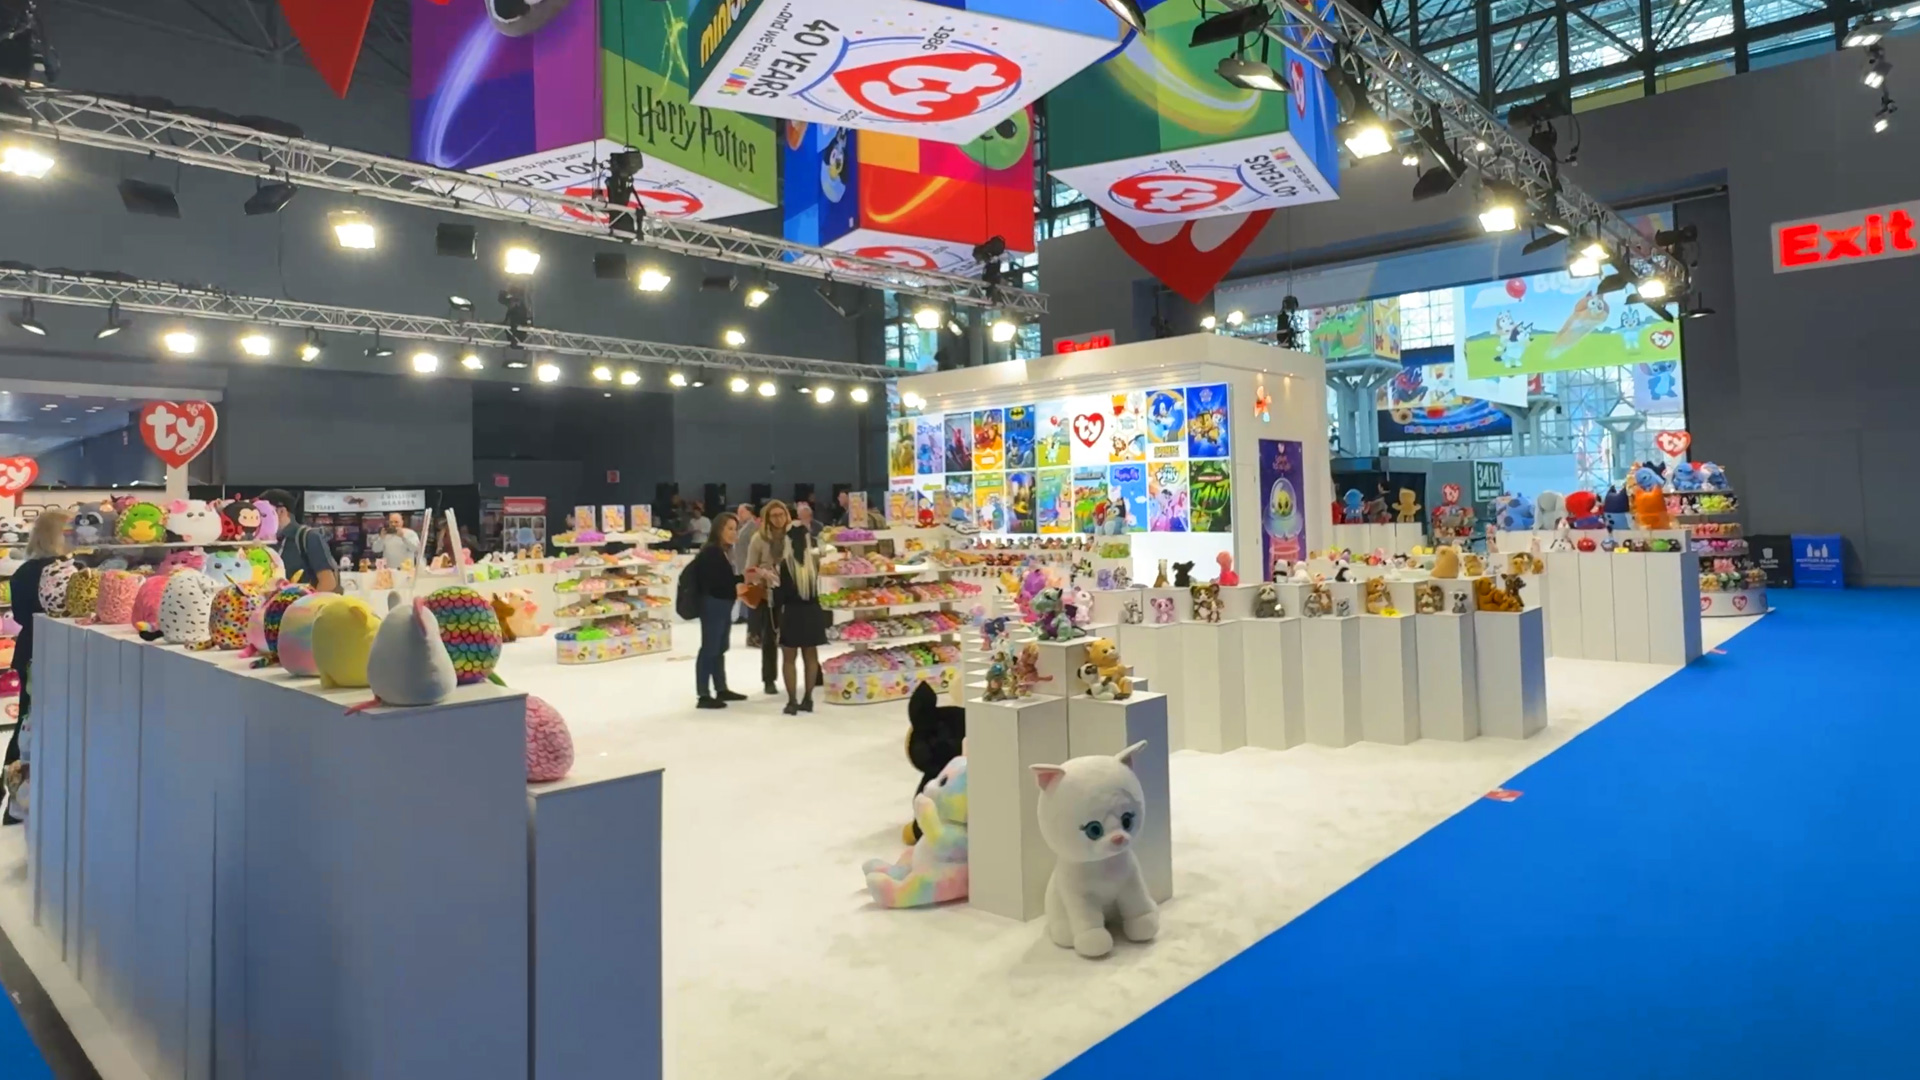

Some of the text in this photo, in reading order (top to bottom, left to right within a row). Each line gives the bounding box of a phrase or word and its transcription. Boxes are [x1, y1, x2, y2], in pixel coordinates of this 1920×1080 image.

[747, 19, 840, 99] 40 YEARS
[921, 25, 956, 51] 1986
[860, 62, 1006, 115] ty
[632, 84, 756, 174] Harry Potter
[1779, 209, 1917, 268] Exit
[146, 405, 206, 456] ty
[1075, 416, 1101, 442] ty
[1659, 433, 1687, 452] ty
[1477, 464, 1500, 487] 3411
